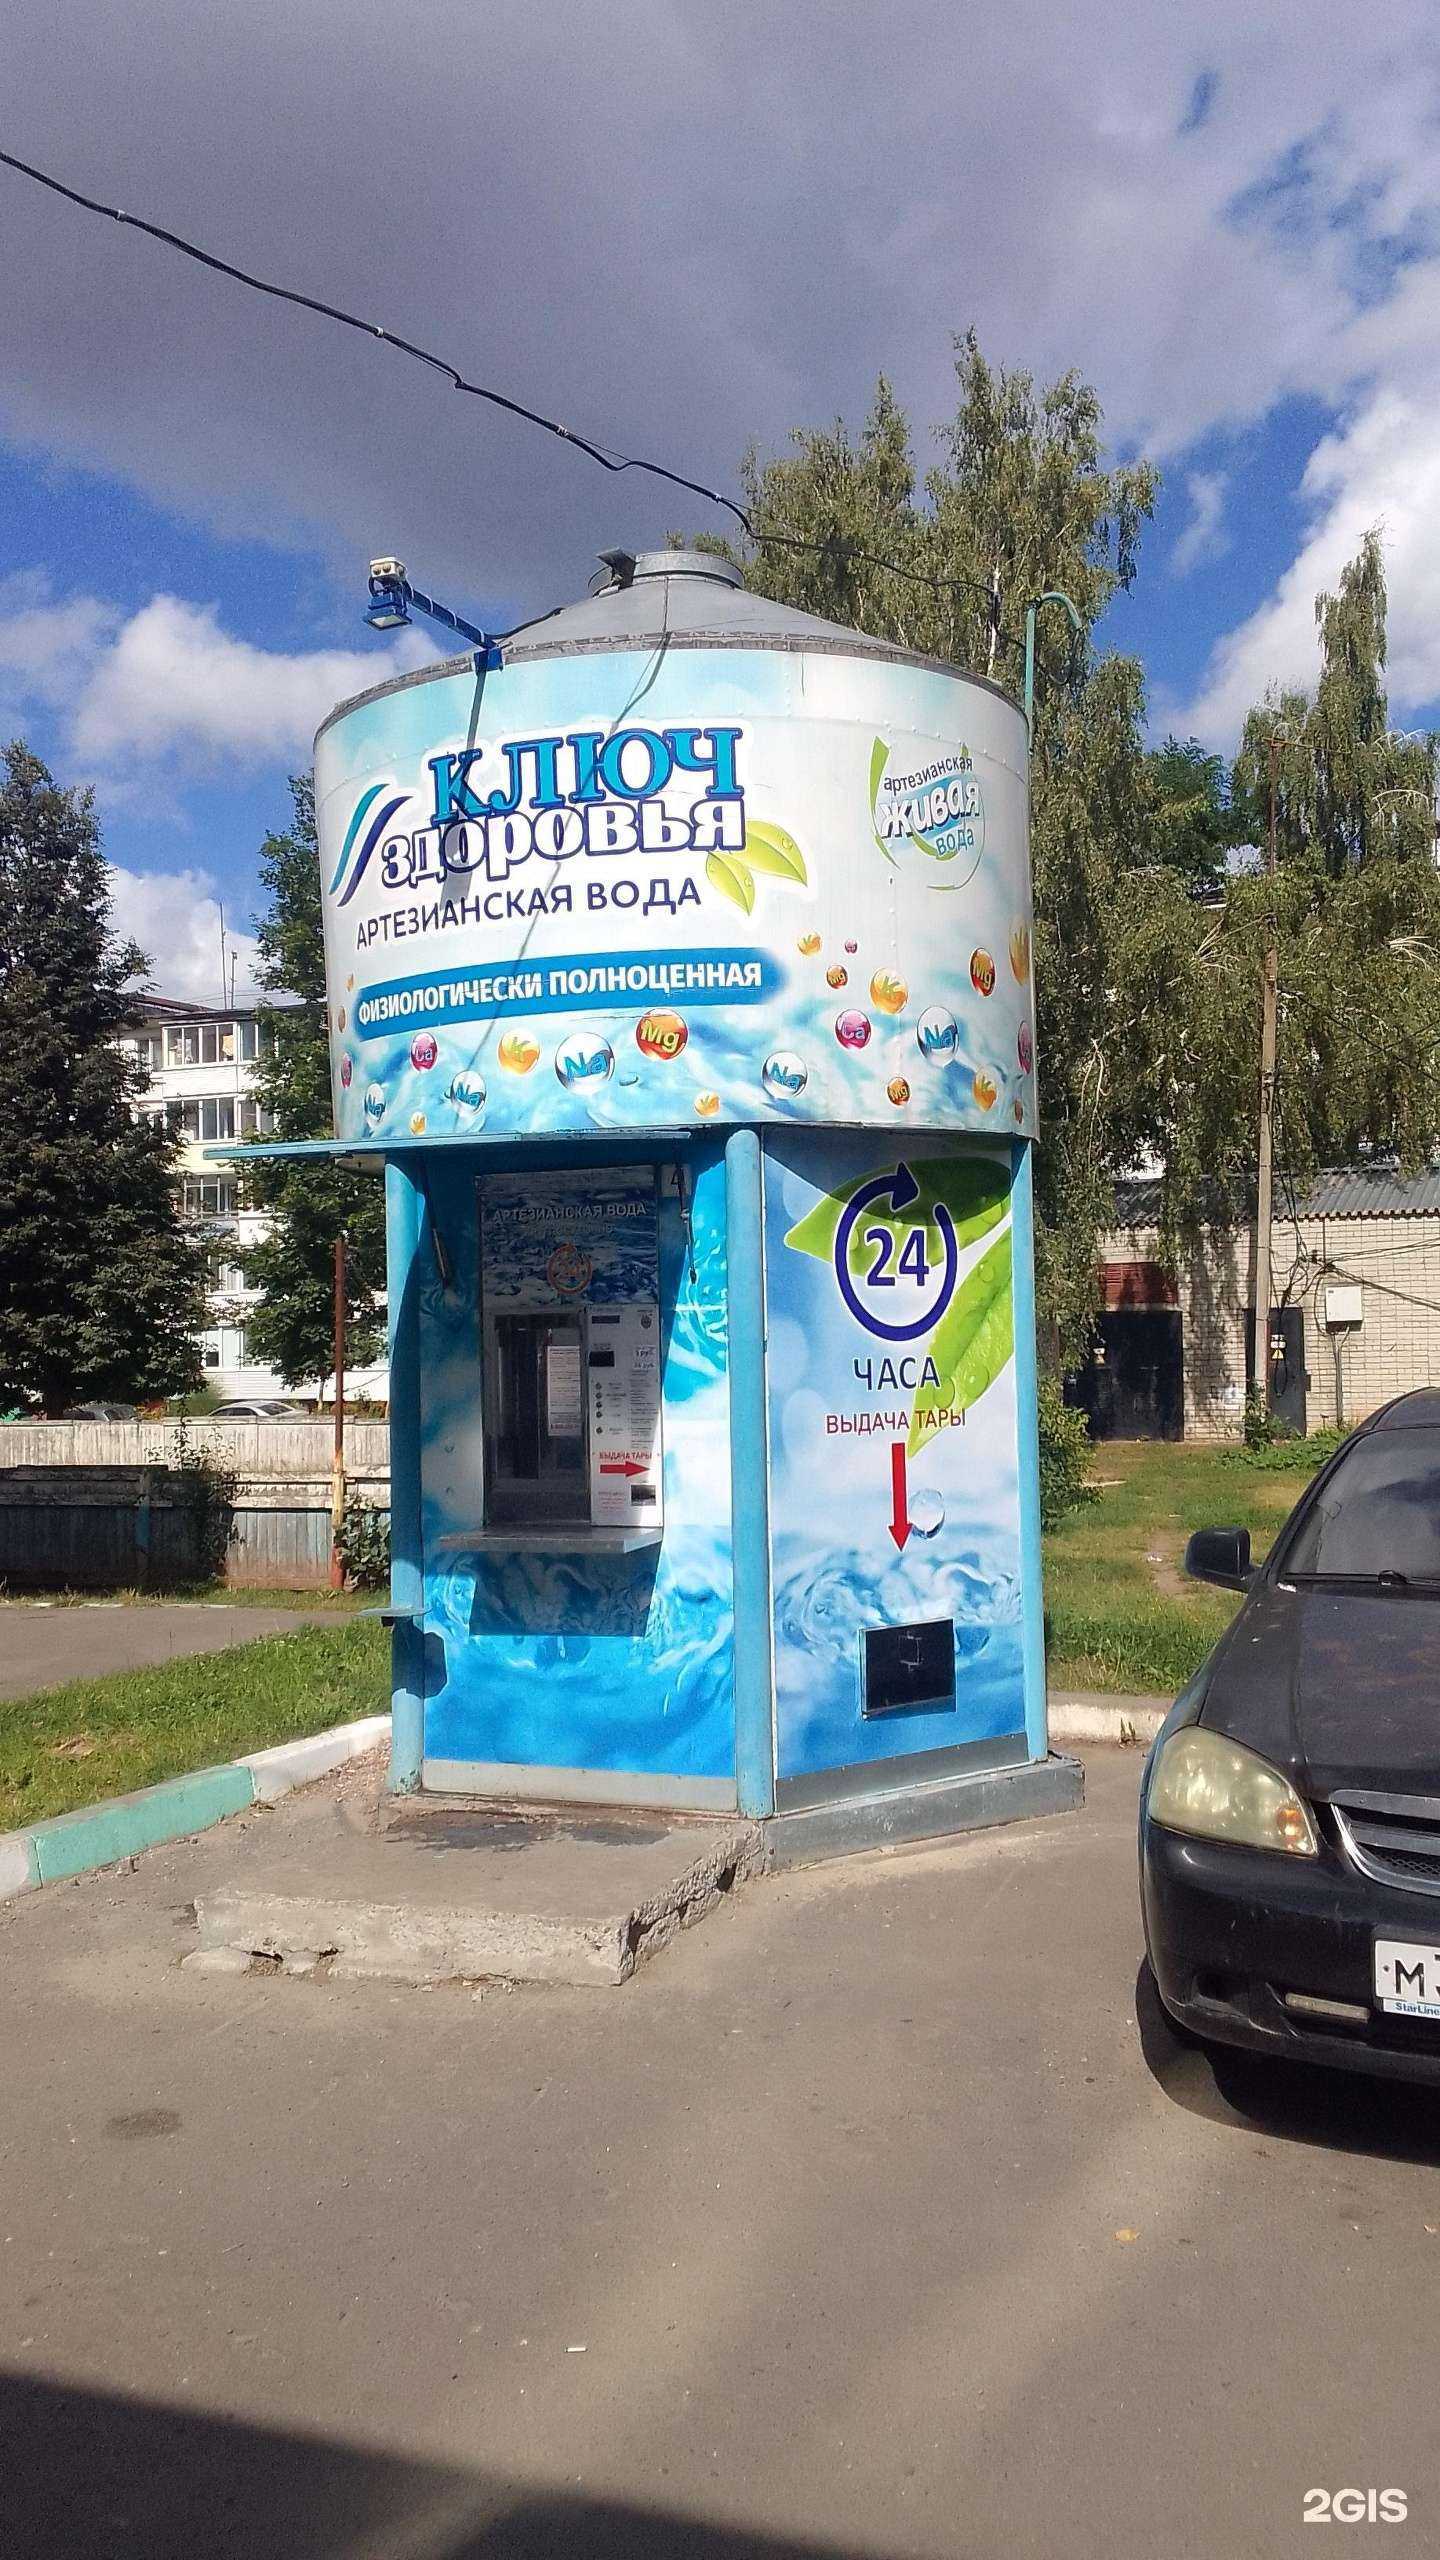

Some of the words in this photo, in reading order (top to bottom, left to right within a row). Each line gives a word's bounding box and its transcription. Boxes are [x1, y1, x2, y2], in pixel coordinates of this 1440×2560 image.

[428, 728, 744, 825] КЛЮЧ
[884, 757, 973, 796] артезианская
[381, 799, 746, 888] здоровья
[936, 829, 975, 855] вода
[356, 884, 573, 950] АРТЕЗИАНСКАЯ
[587, 876, 701, 915] ВОДА
[972, 961, 992, 990] Mg
[358, 972, 542, 1026] ФИЗИОЛОГИЧЕСКИ
[549, 962, 762, 998] ПОЛНОЦЕННАЯ
[640, 1018, 681, 1053] Mg
[563, 1051, 609, 1080] Na
[770, 1061, 801, 1089] Na
[494, 1204, 603, 1225] АРТЕЗИАНСКАЯ
[607, 1202, 648, 1218] ВОДА
[866, 1226, 930, 1288] 24
[853, 1356, 941, 1392] ЧАСА
[826, 1410, 910, 1436] ВЫДАЧА
[914, 1407, 966, 1430] ТАРЫ
[600, 1451, 630, 1461] ВЫДАЧА
